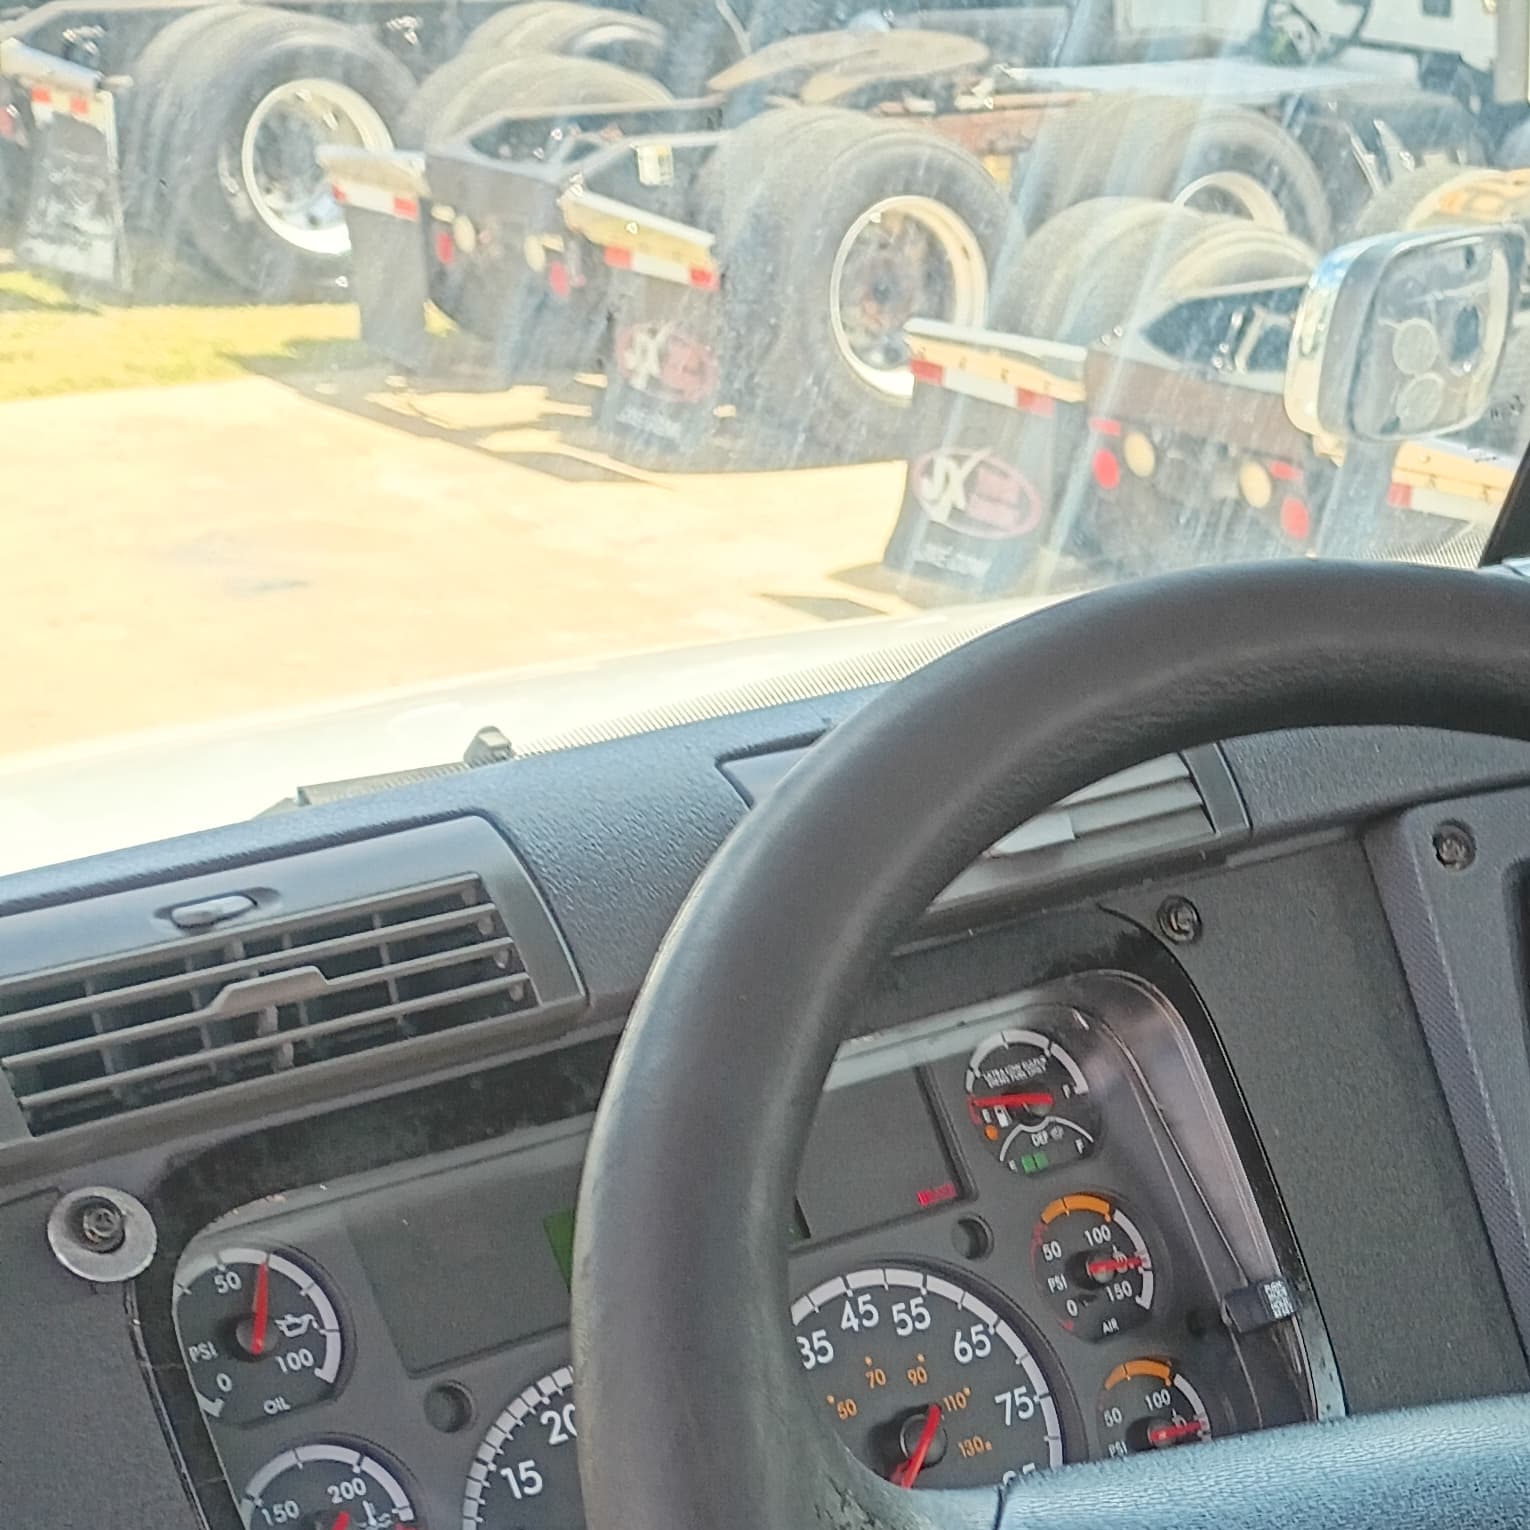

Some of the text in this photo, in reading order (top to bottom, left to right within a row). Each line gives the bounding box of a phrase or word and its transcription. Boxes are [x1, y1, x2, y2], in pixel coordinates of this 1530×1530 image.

[1084, 1224, 1112, 1247] 100
[213, 1271, 242, 1294] 50
[1047, 1273, 1068, 1294] PSI
[1106, 1280, 1133, 1302] 150
[840, 1293, 879, 1332] 45
[891, 1296, 931, 1336] 55
[1066, 1299, 1078, 1317] 0
[1102, 1318, 1120, 1335] AIR
[188, 1341, 219, 1363] PSI
[796, 1329, 834, 1370] 35
[953, 1324, 992, 1364] 65
[275, 1348, 314, 1374] 100
[216, 1372, 233, 1392] 0
[864, 1367, 887, 1389] 70
[906, 1366, 928, 1387] 90
[263, 1396, 291, 1415] OIL
[943, 1391, 968, 1412] 110
[994, 1386, 1035, 1426] 75
[1144, 1388, 1171, 1411] 100
[957, 1435, 985, 1458] 130
[327, 1477, 367, 1504] 200
[500, 1459, 544, 1500] 15
[261, 1500, 300, 1527] 150
